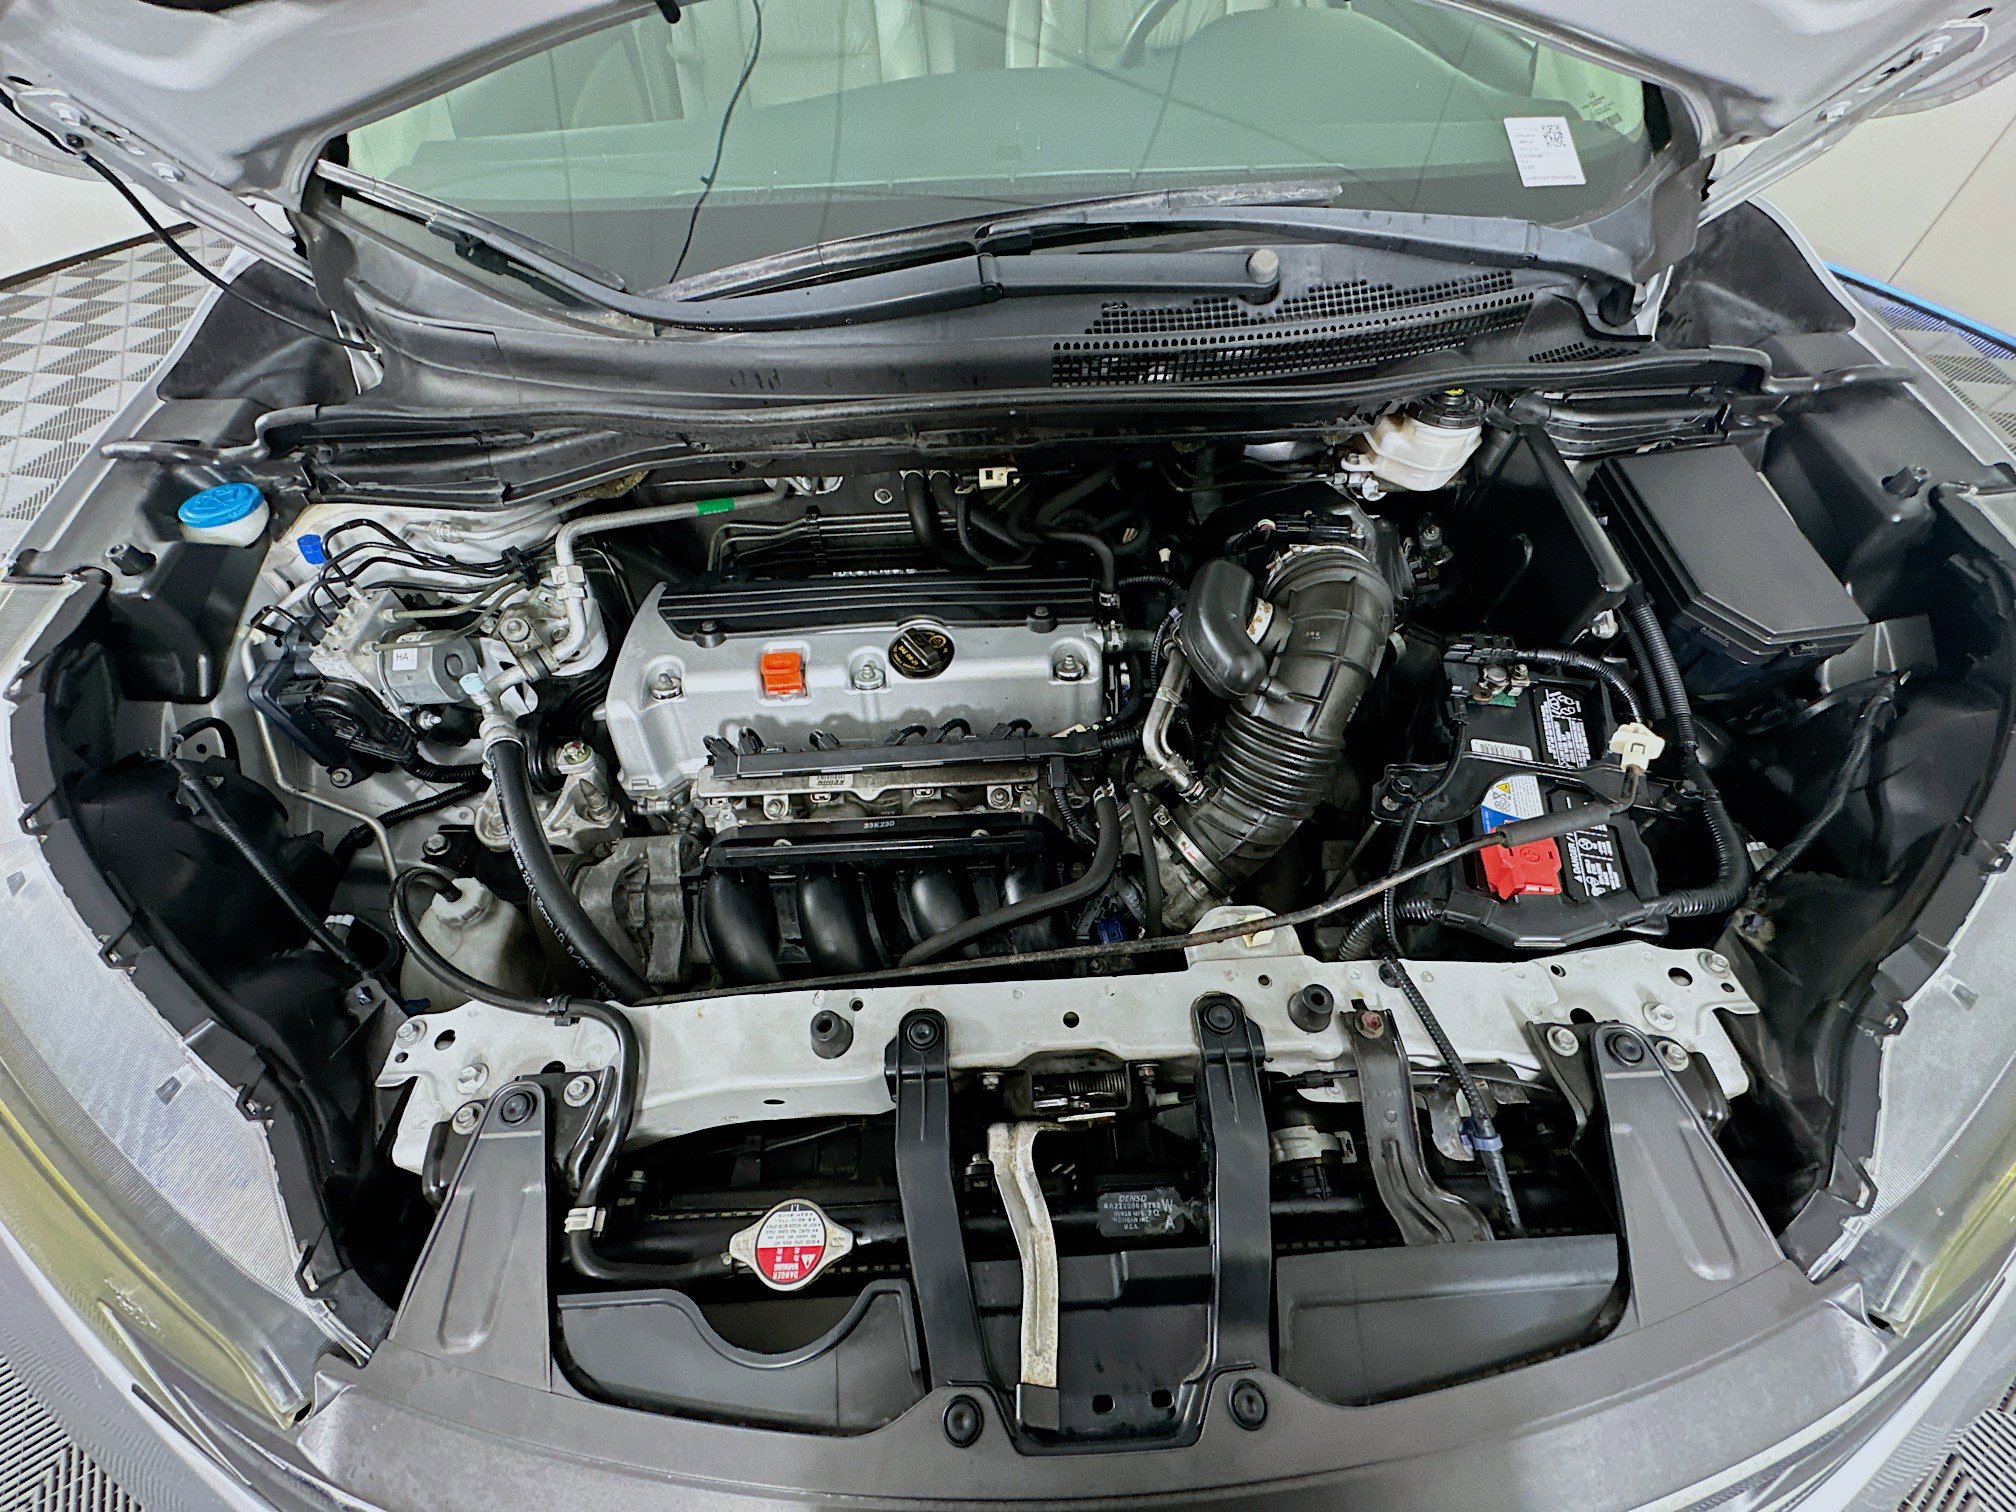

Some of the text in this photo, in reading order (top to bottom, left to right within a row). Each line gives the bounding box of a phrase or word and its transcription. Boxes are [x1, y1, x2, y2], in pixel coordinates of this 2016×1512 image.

[396, 652, 409, 661] HA
[1161, 1198, 1174, 1213] W
[1164, 1214, 1176, 1230] A
[773, 1270, 799, 1280] DANGER
